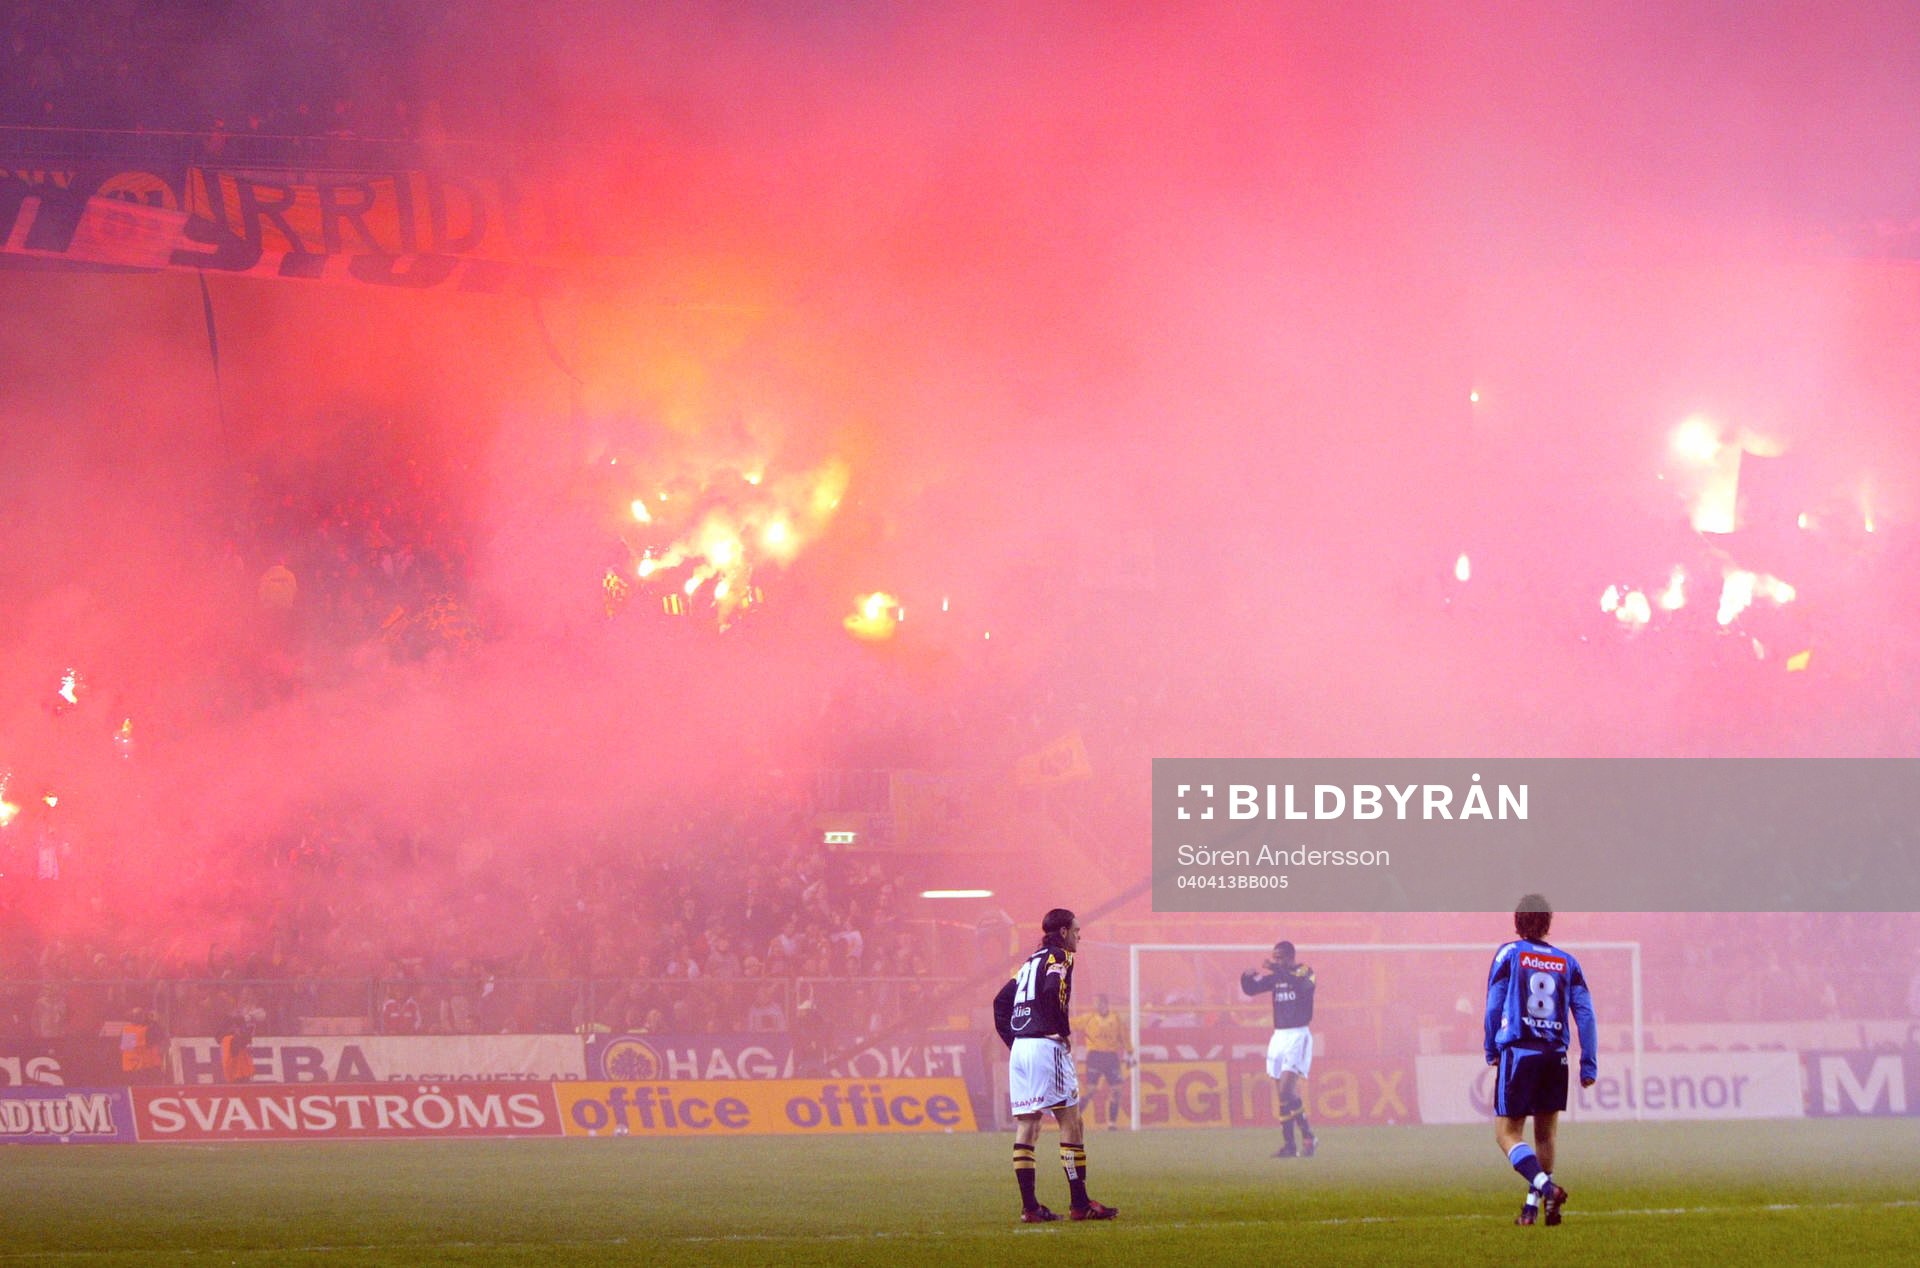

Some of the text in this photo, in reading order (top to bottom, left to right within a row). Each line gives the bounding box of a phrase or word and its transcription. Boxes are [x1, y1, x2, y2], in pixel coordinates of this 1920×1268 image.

[1014, 957, 1042, 1006] 21
[1521, 955, 1565, 971] Adecco
[1526, 971, 1556, 1018] 8
[1521, 1016, 1563, 1031] VOLVO
[147, 1085, 547, 1134] SVANSTRÖMS
[571, 1086, 751, 1131] office
[785, 1083, 963, 1129] office
[1576, 1067, 1749, 1111] telenor
